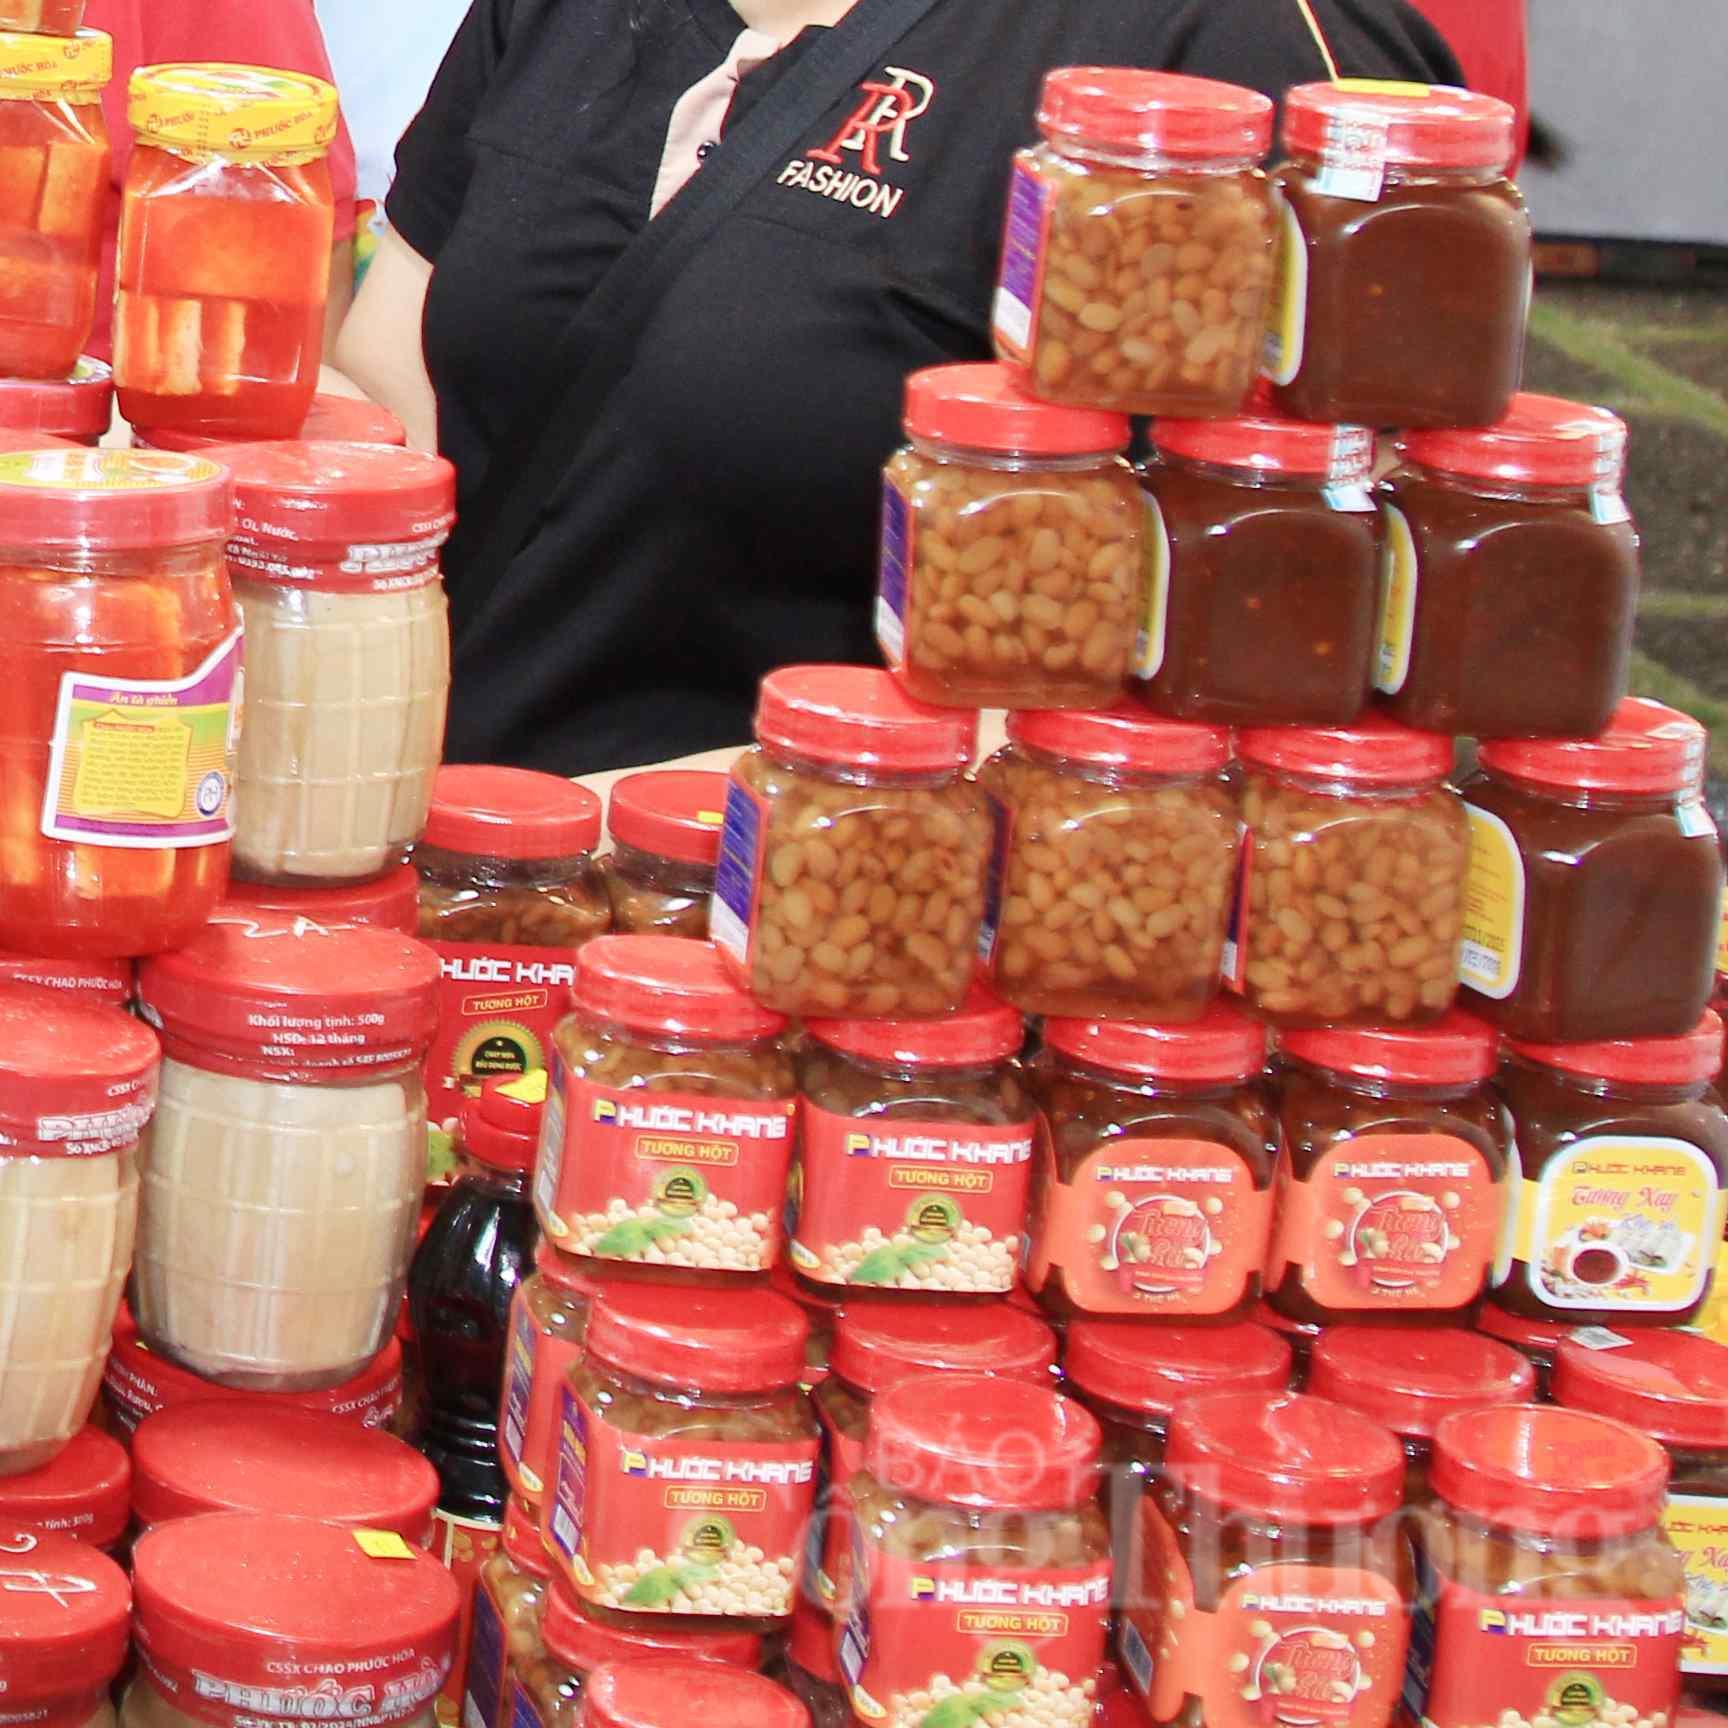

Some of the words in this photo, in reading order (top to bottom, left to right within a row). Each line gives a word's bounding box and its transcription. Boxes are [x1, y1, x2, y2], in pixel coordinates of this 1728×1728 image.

[775, 160, 904, 218] FASHION
[594, 1099, 694, 1133] PHƯỚC
[694, 1112, 789, 1140] KHANG
[642, 1139, 696, 1158] TƯƠNG
[698, 1142, 734, 1161] HỘT
[846, 1132, 947, 1165] PHƯỚC
[949, 1138, 1034, 1164] KHANG
[895, 1170, 950, 1188] TƯƠNG
[952, 1171, 988, 1190] HỘT
[1635, 1184, 1680, 1214] Xay
[621, 1450, 724, 1484] PHƯỚC
[725, 1457, 812, 1485] KHANG
[670, 1488, 724, 1508] TƯƠNG
[726, 1489, 762, 1511] HỘT
[911, 1576, 1019, 1606] PHƯỚC
[1020, 1579, 1110, 1607] KHANG
[962, 1612, 1022, 1633] TƯƠNG
[1024, 1614, 1062, 1635] HỘT
[1480, 1609, 1590, 1638] PHƯỚC
[1590, 1610, 1682, 1639] KHANG
[303, 1660, 346, 1676] CHAO
[1534, 1645, 1594, 1664] TƯƠNG
[1596, 1646, 1631, 1666] HỘT
